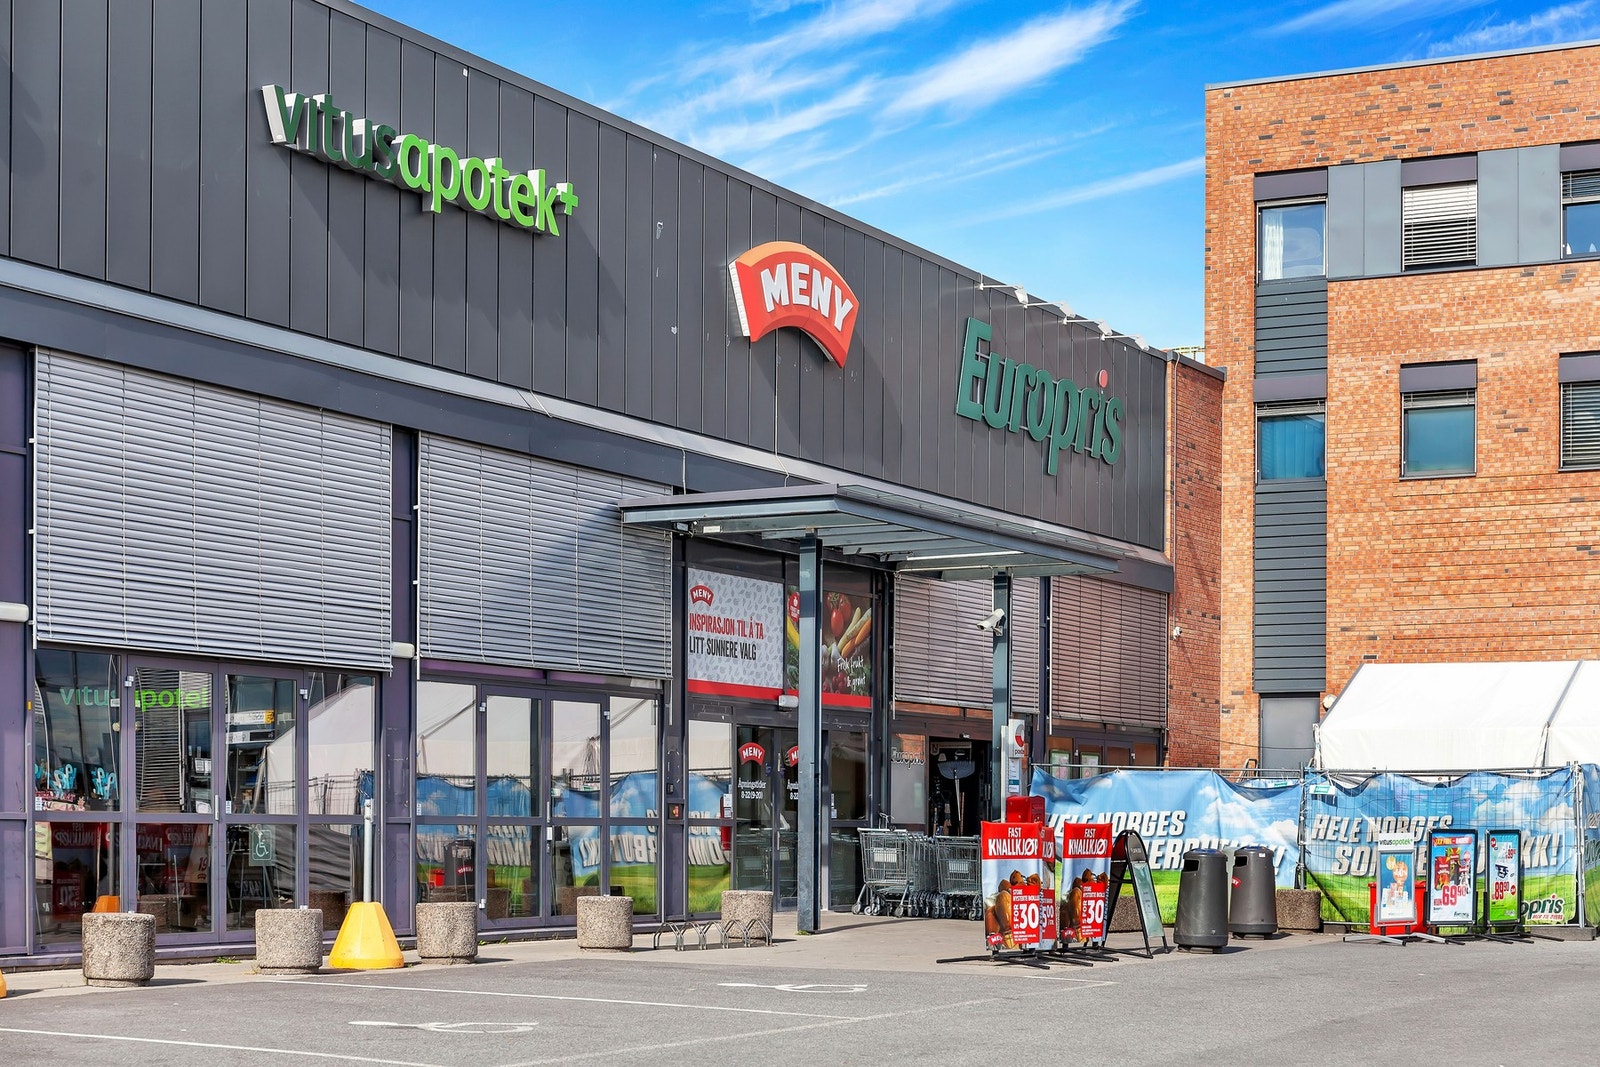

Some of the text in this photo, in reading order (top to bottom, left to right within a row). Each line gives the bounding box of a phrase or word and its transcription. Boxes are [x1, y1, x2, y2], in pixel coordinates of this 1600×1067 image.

[760, 262, 854, 332] MENY
[956, 317, 1123, 476] Europris
[692, 589, 712, 600] MENY
[689, 612, 764, 640] INSPIRASJON TIL Å TA
[689, 635, 757, 660] LITT SUNNERE VALG
[742, 746, 763, 760] MENY
[1008, 827, 1022, 837] FAST
[1084, 828, 1096, 838] FAST
[1311, 814, 1363, 843] HELE
[988, 838, 1039, 856] KNALLKJØP
[1068, 838, 1108, 855] KNALLKJØP
[1019, 903, 1039, 929] 30
[1086, 899, 1104, 924] 30
[1521, 894, 1564, 920] opris
